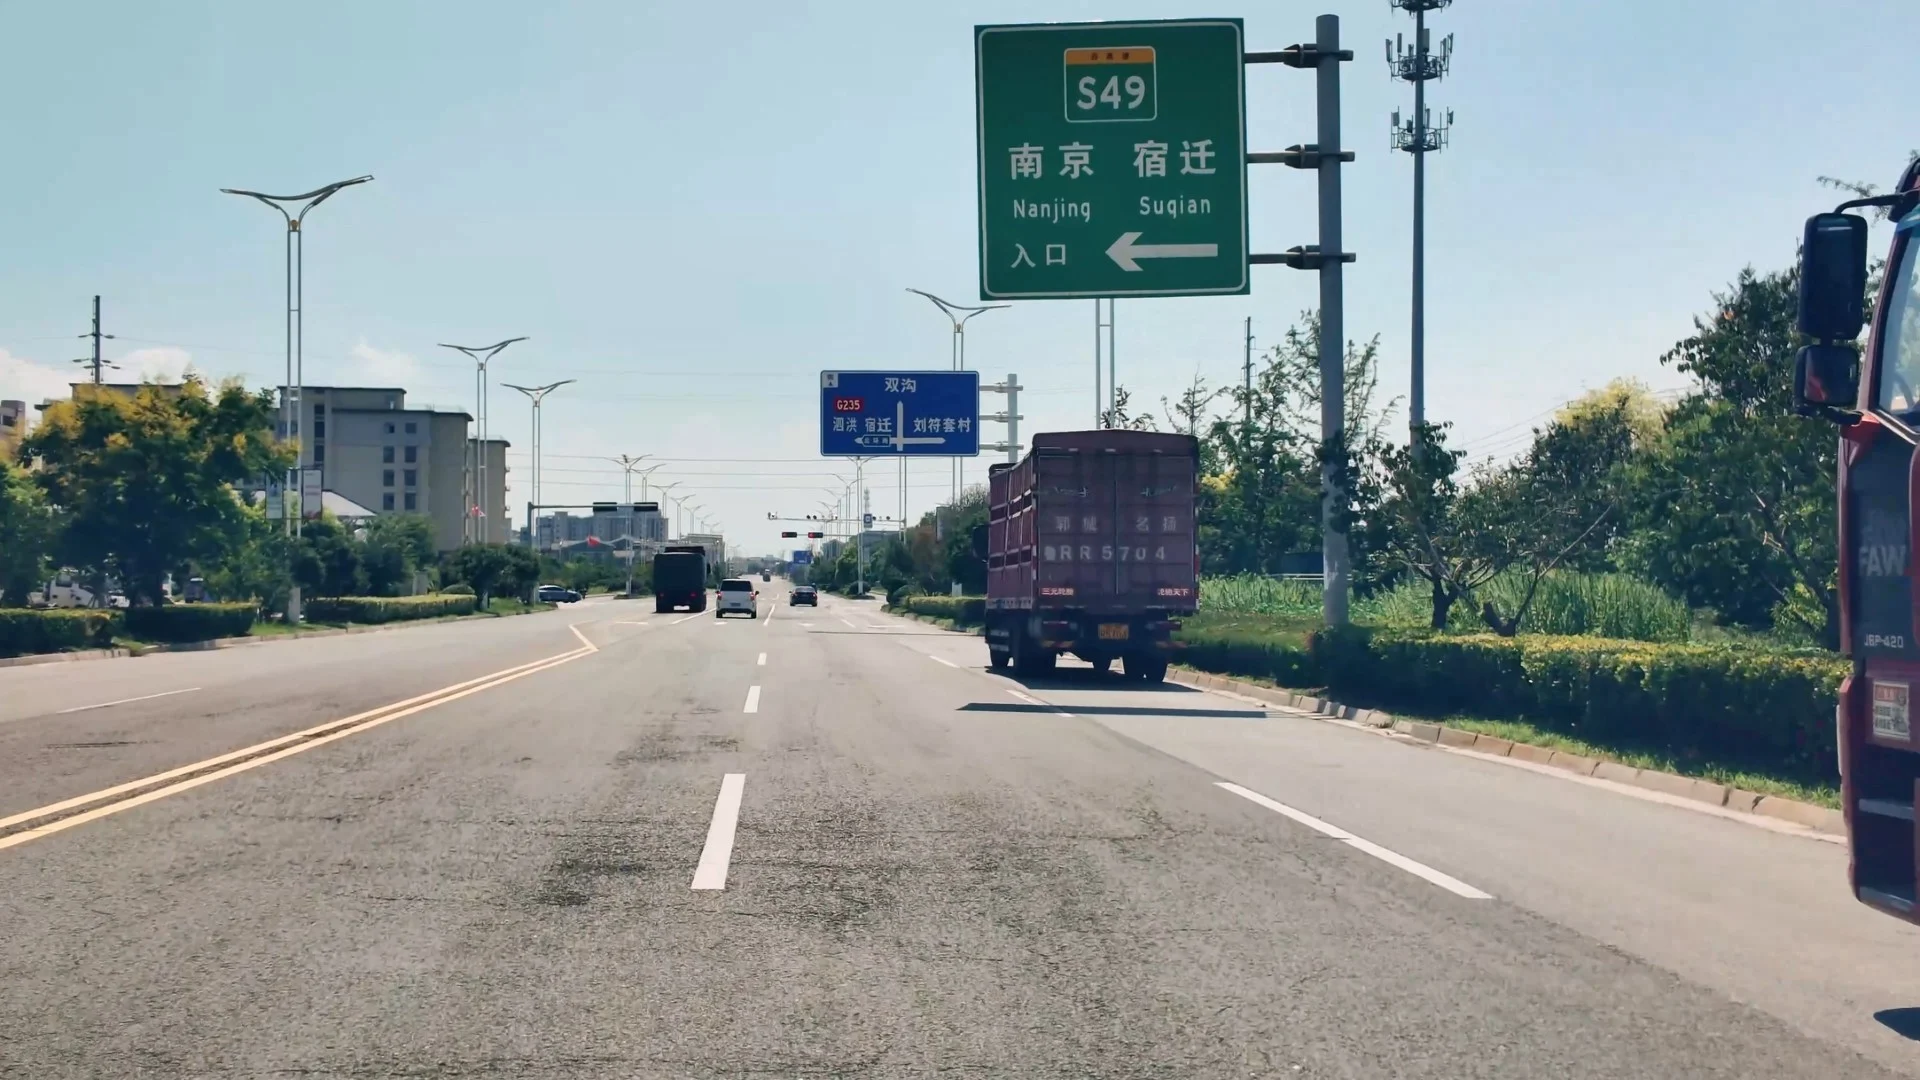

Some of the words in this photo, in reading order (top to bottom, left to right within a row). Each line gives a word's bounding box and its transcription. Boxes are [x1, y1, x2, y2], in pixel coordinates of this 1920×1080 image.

[1076, 75, 1146, 110] S49
[1008, 142, 1094, 180] 南京
[1132, 139, 1216, 178] 宿迁
[1013, 197, 1091, 223] Nanjing
[1139, 194, 1211, 219] Suqian
[1011, 242, 1067, 268] 入口
[884, 377, 917, 393] 双沟
[837, 399, 860, 411] G235
[832, 416, 857, 432] 泗洪
[865, 417, 892, 433] 宿迁
[913, 417, 972, 433] 刘符套村
[1859, 544, 1906, 577] FAW
